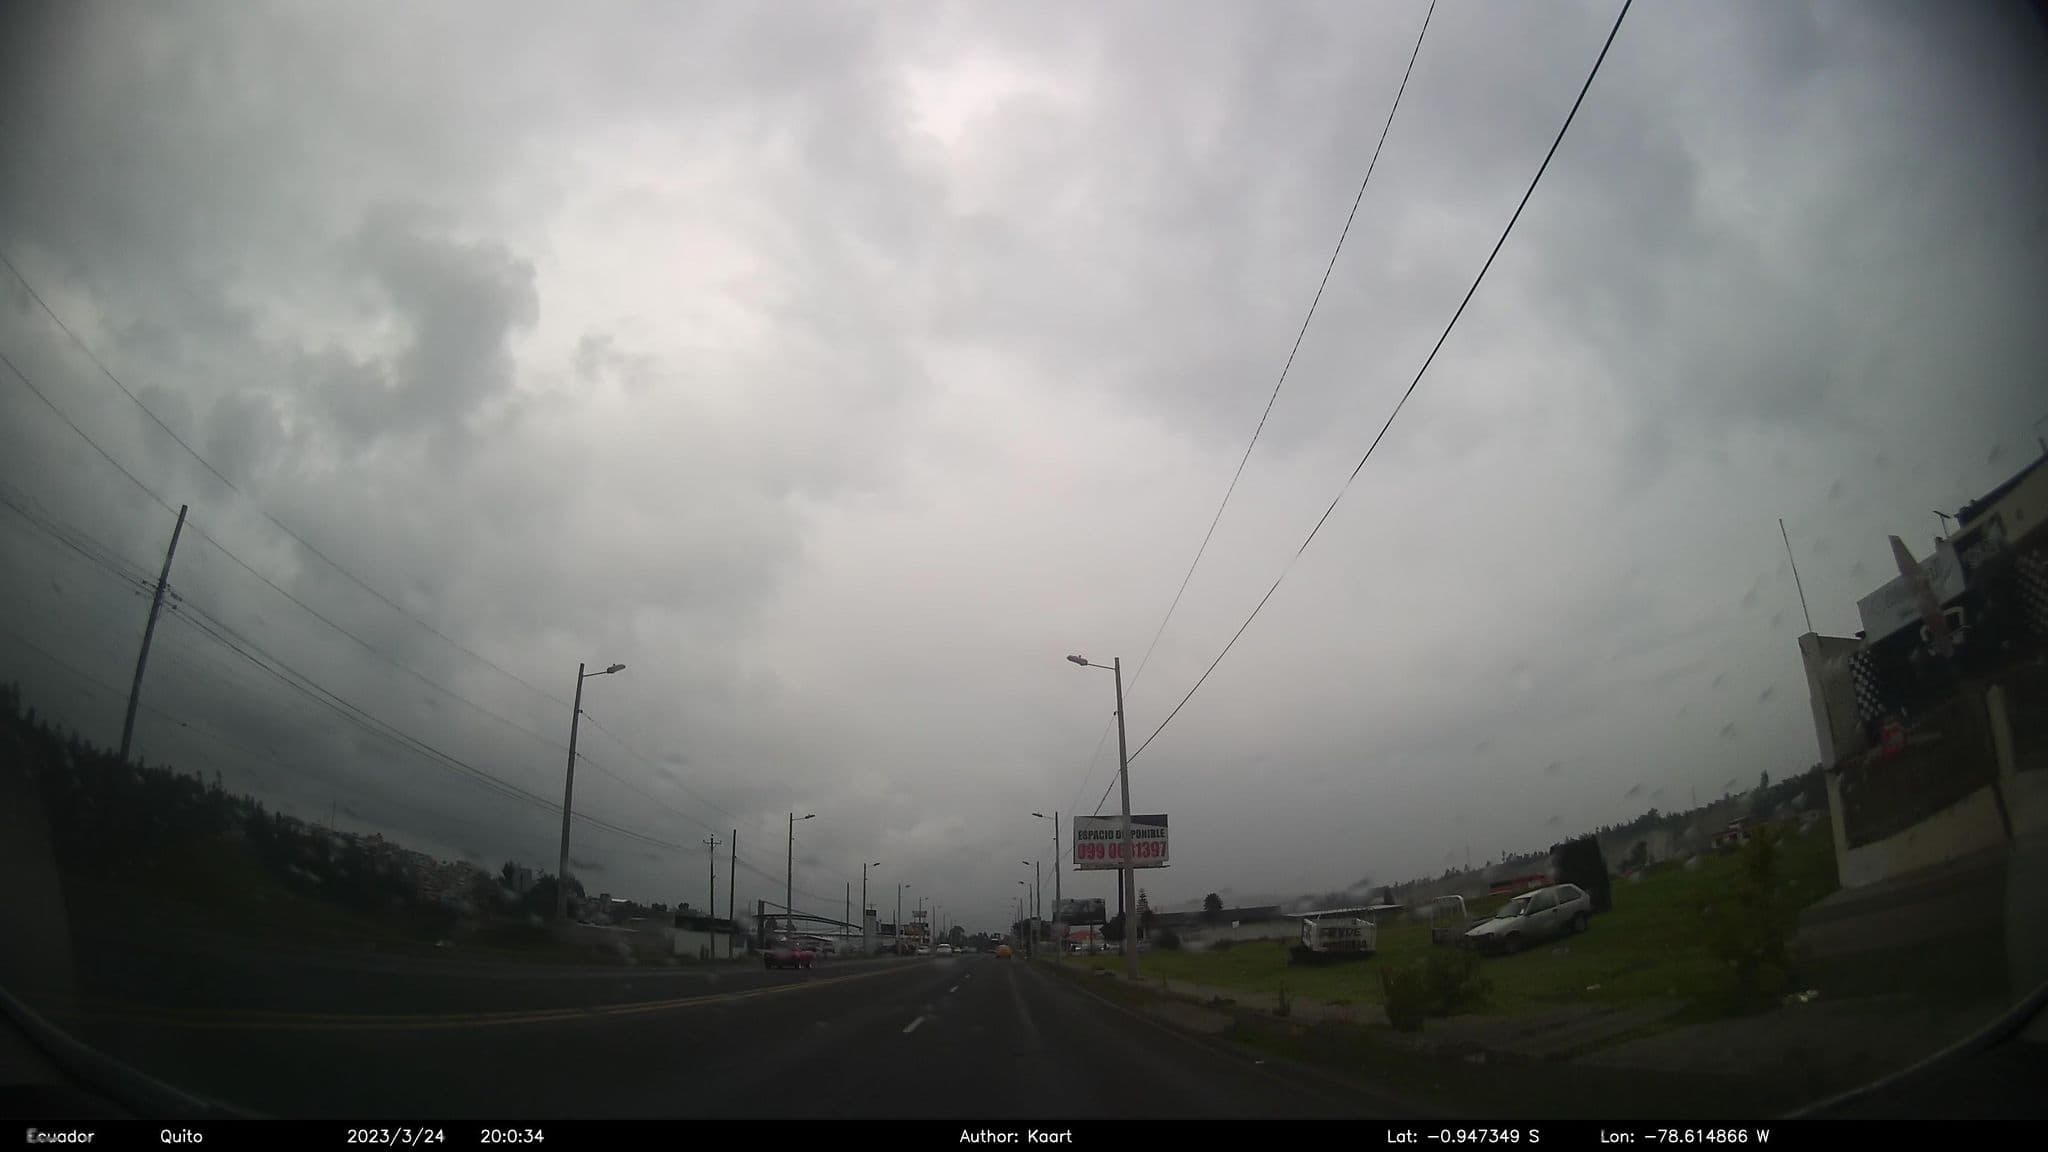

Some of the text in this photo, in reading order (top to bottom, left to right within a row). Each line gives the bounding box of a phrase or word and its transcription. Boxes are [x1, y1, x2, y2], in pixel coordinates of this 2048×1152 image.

[1078, 828, 1166, 841] ESPACIO DIPONIBLE
[1077, 842, 1105, 860] 099
